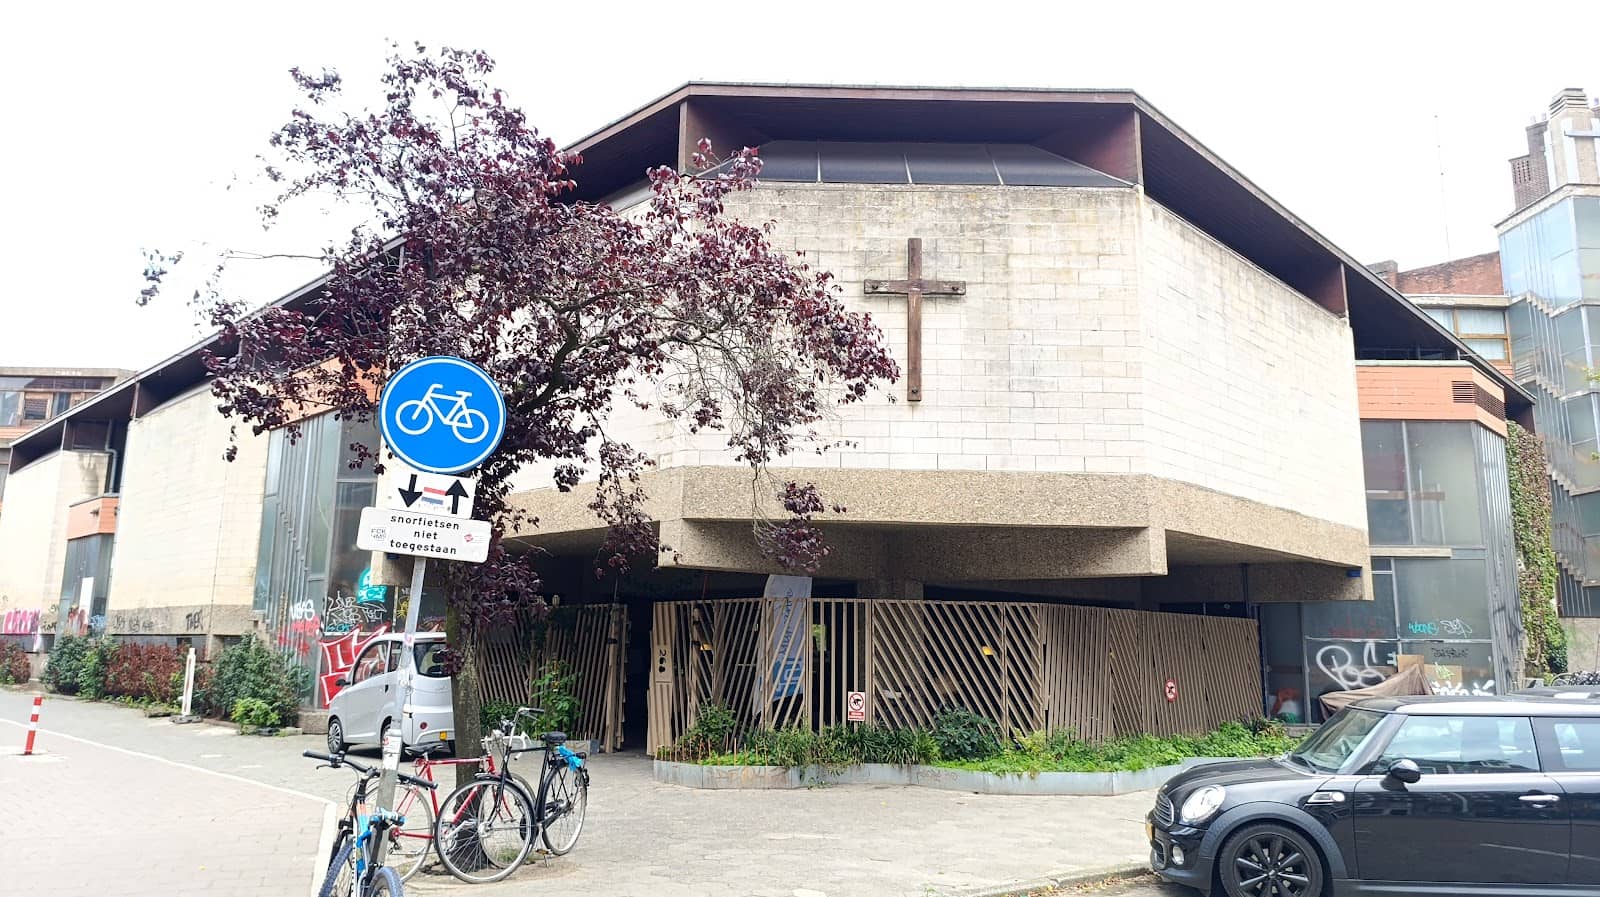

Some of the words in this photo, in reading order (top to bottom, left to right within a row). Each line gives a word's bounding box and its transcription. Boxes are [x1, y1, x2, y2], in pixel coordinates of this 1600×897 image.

[390, 515, 460, 530] snorfietsen
[413, 530, 438, 540] niet
[390, 539, 457, 554] toegestaan
